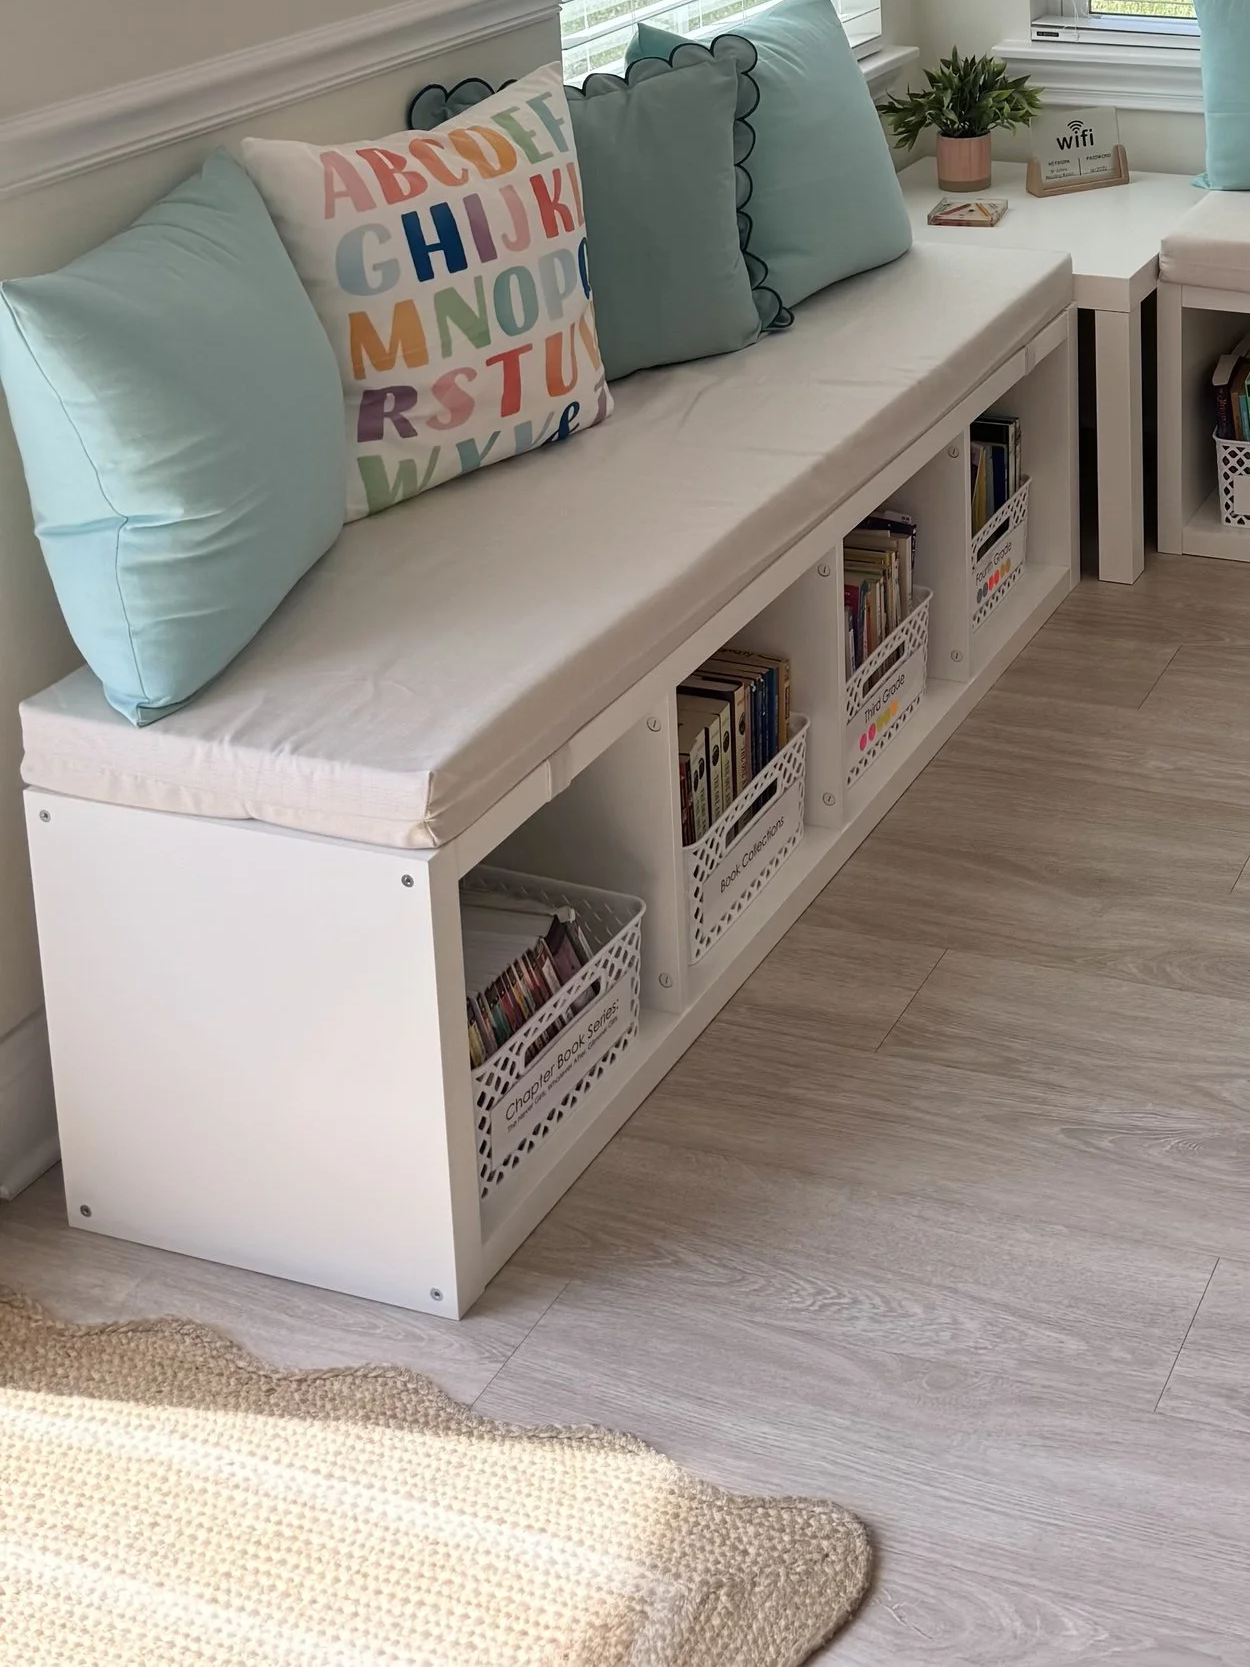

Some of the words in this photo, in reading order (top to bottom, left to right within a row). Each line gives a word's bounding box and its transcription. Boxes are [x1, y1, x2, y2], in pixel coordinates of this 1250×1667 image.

[319, 92, 569, 219] ABCDEF
[1056, 129, 1094, 151] wifi
[976, 561, 993, 586] Fourth
[993, 542, 1012, 565] Grade
[865, 695, 881, 723] Third
[883, 674, 905, 703] Grade
[721, 864, 741, 893] Book
[742, 816, 784, 868] Collections
[506, 1064, 555, 1121] Chapter
[557, 1034, 585, 1069] Book
[587, 999, 620, 1038] Series:
